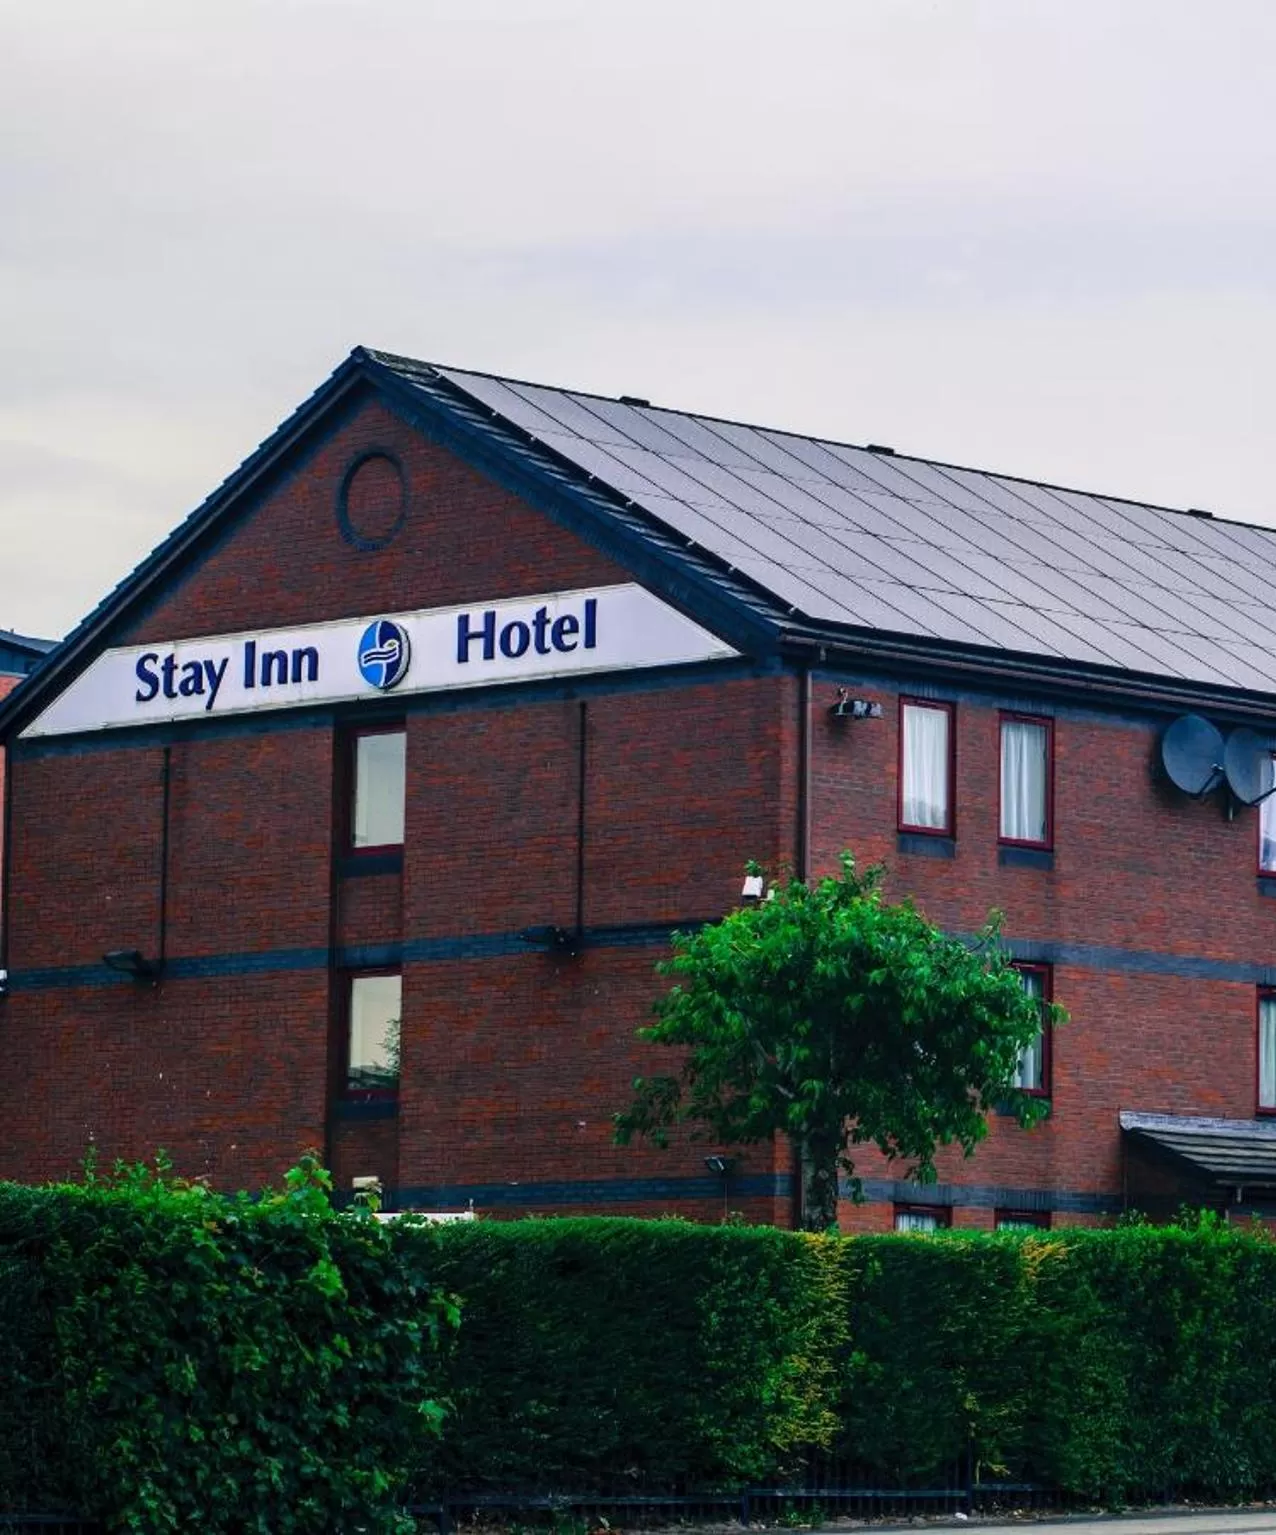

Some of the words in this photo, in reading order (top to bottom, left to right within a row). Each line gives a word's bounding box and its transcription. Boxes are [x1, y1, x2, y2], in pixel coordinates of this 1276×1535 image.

[135, 653, 228, 710] Stay
[243, 640, 319, 689] Inn
[457, 600, 598, 663] Hotel
